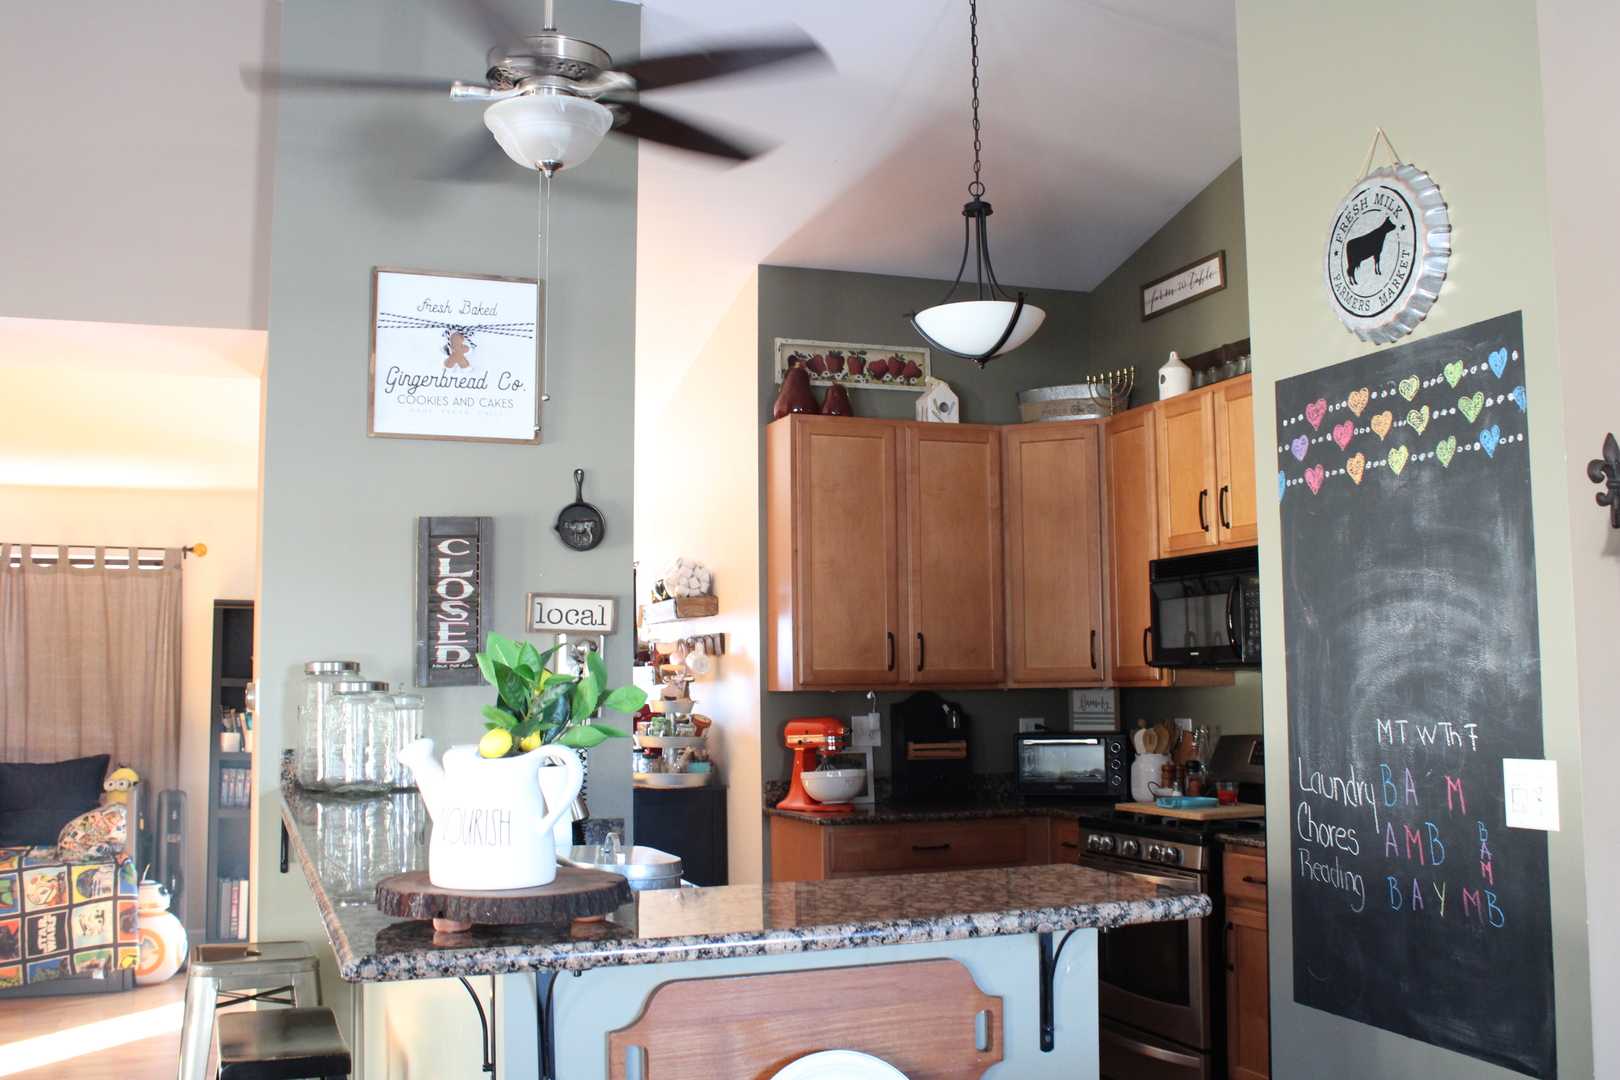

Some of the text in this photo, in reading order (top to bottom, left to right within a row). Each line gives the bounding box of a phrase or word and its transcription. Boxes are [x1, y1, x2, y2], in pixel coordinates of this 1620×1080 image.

[1336, 192, 1403, 244] FRESH MILK
[1333, 249, 1411, 312] FARMERS MARKET
[459, 300, 498, 316] Baked
[385, 366, 488, 394] Gingerbread
[397, 394, 514, 408] COOKIES AND CAKES
[436, 538, 474, 664] CLOSED
[535, 602, 607, 626] local
[1298, 756, 1380, 834] Laundry
[1445, 775, 1466, 815] M
[1297, 802, 1359, 856] Chores
[1298, 848, 1365, 912] Reading
[38, 914, 48, 953] STAR
[47, 914, 57, 953] WARS
